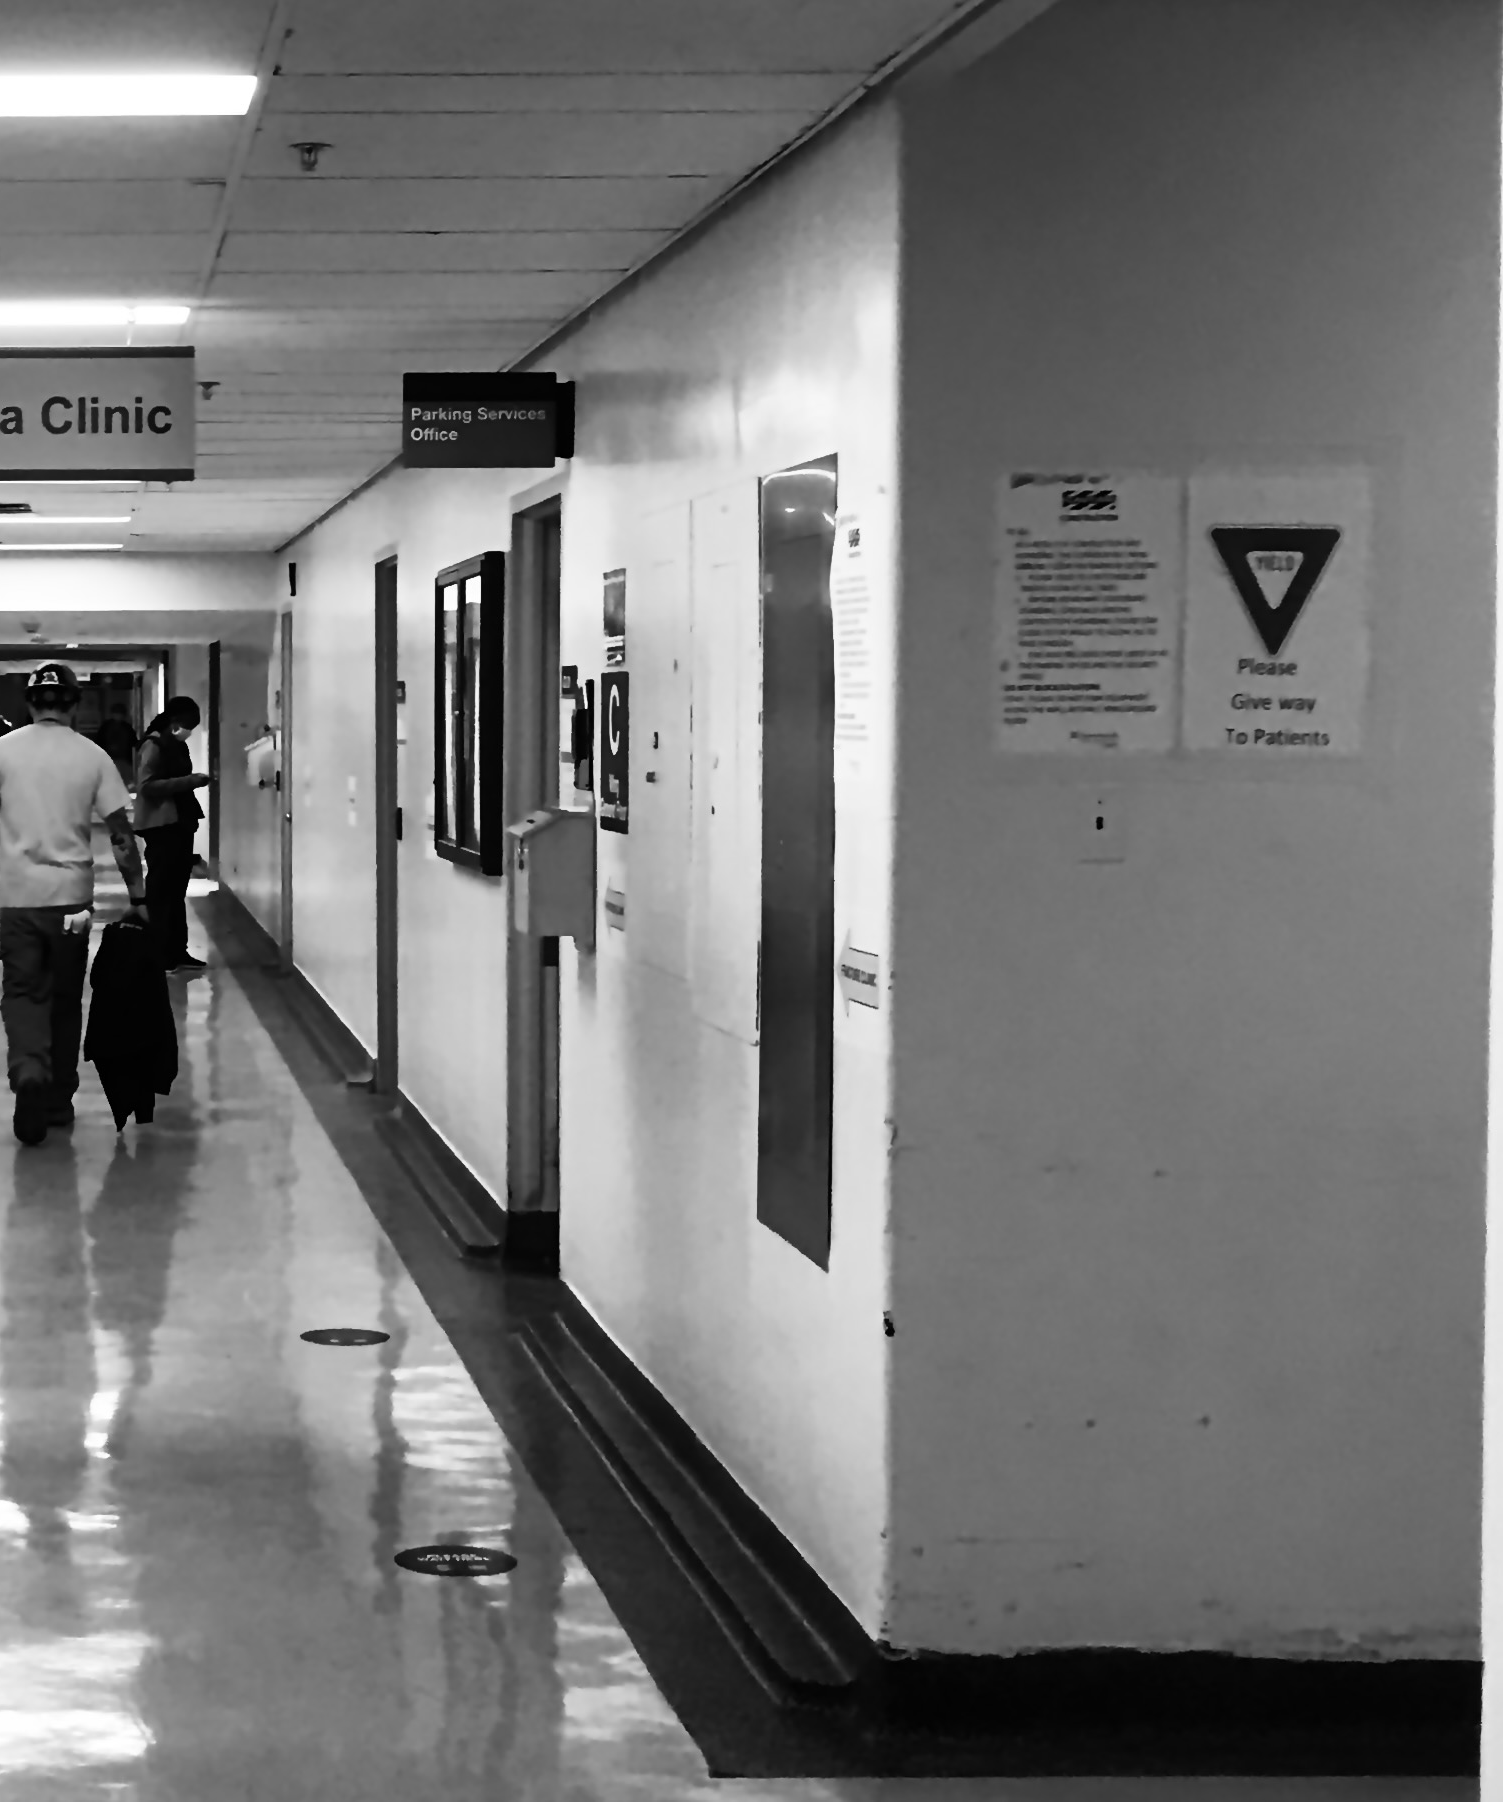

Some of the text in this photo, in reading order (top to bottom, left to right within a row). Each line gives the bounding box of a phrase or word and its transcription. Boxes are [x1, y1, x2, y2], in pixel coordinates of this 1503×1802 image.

[40, 396, 173, 435] Clinic
[411, 407, 546, 424] Parking Services
[410, 427, 458, 441] Office
[1237, 658, 1298, 676] Please
[1230, 693, 1317, 714] Give way
[609, 684, 620, 756] C
[1225, 728, 1330, 746] To Patients
